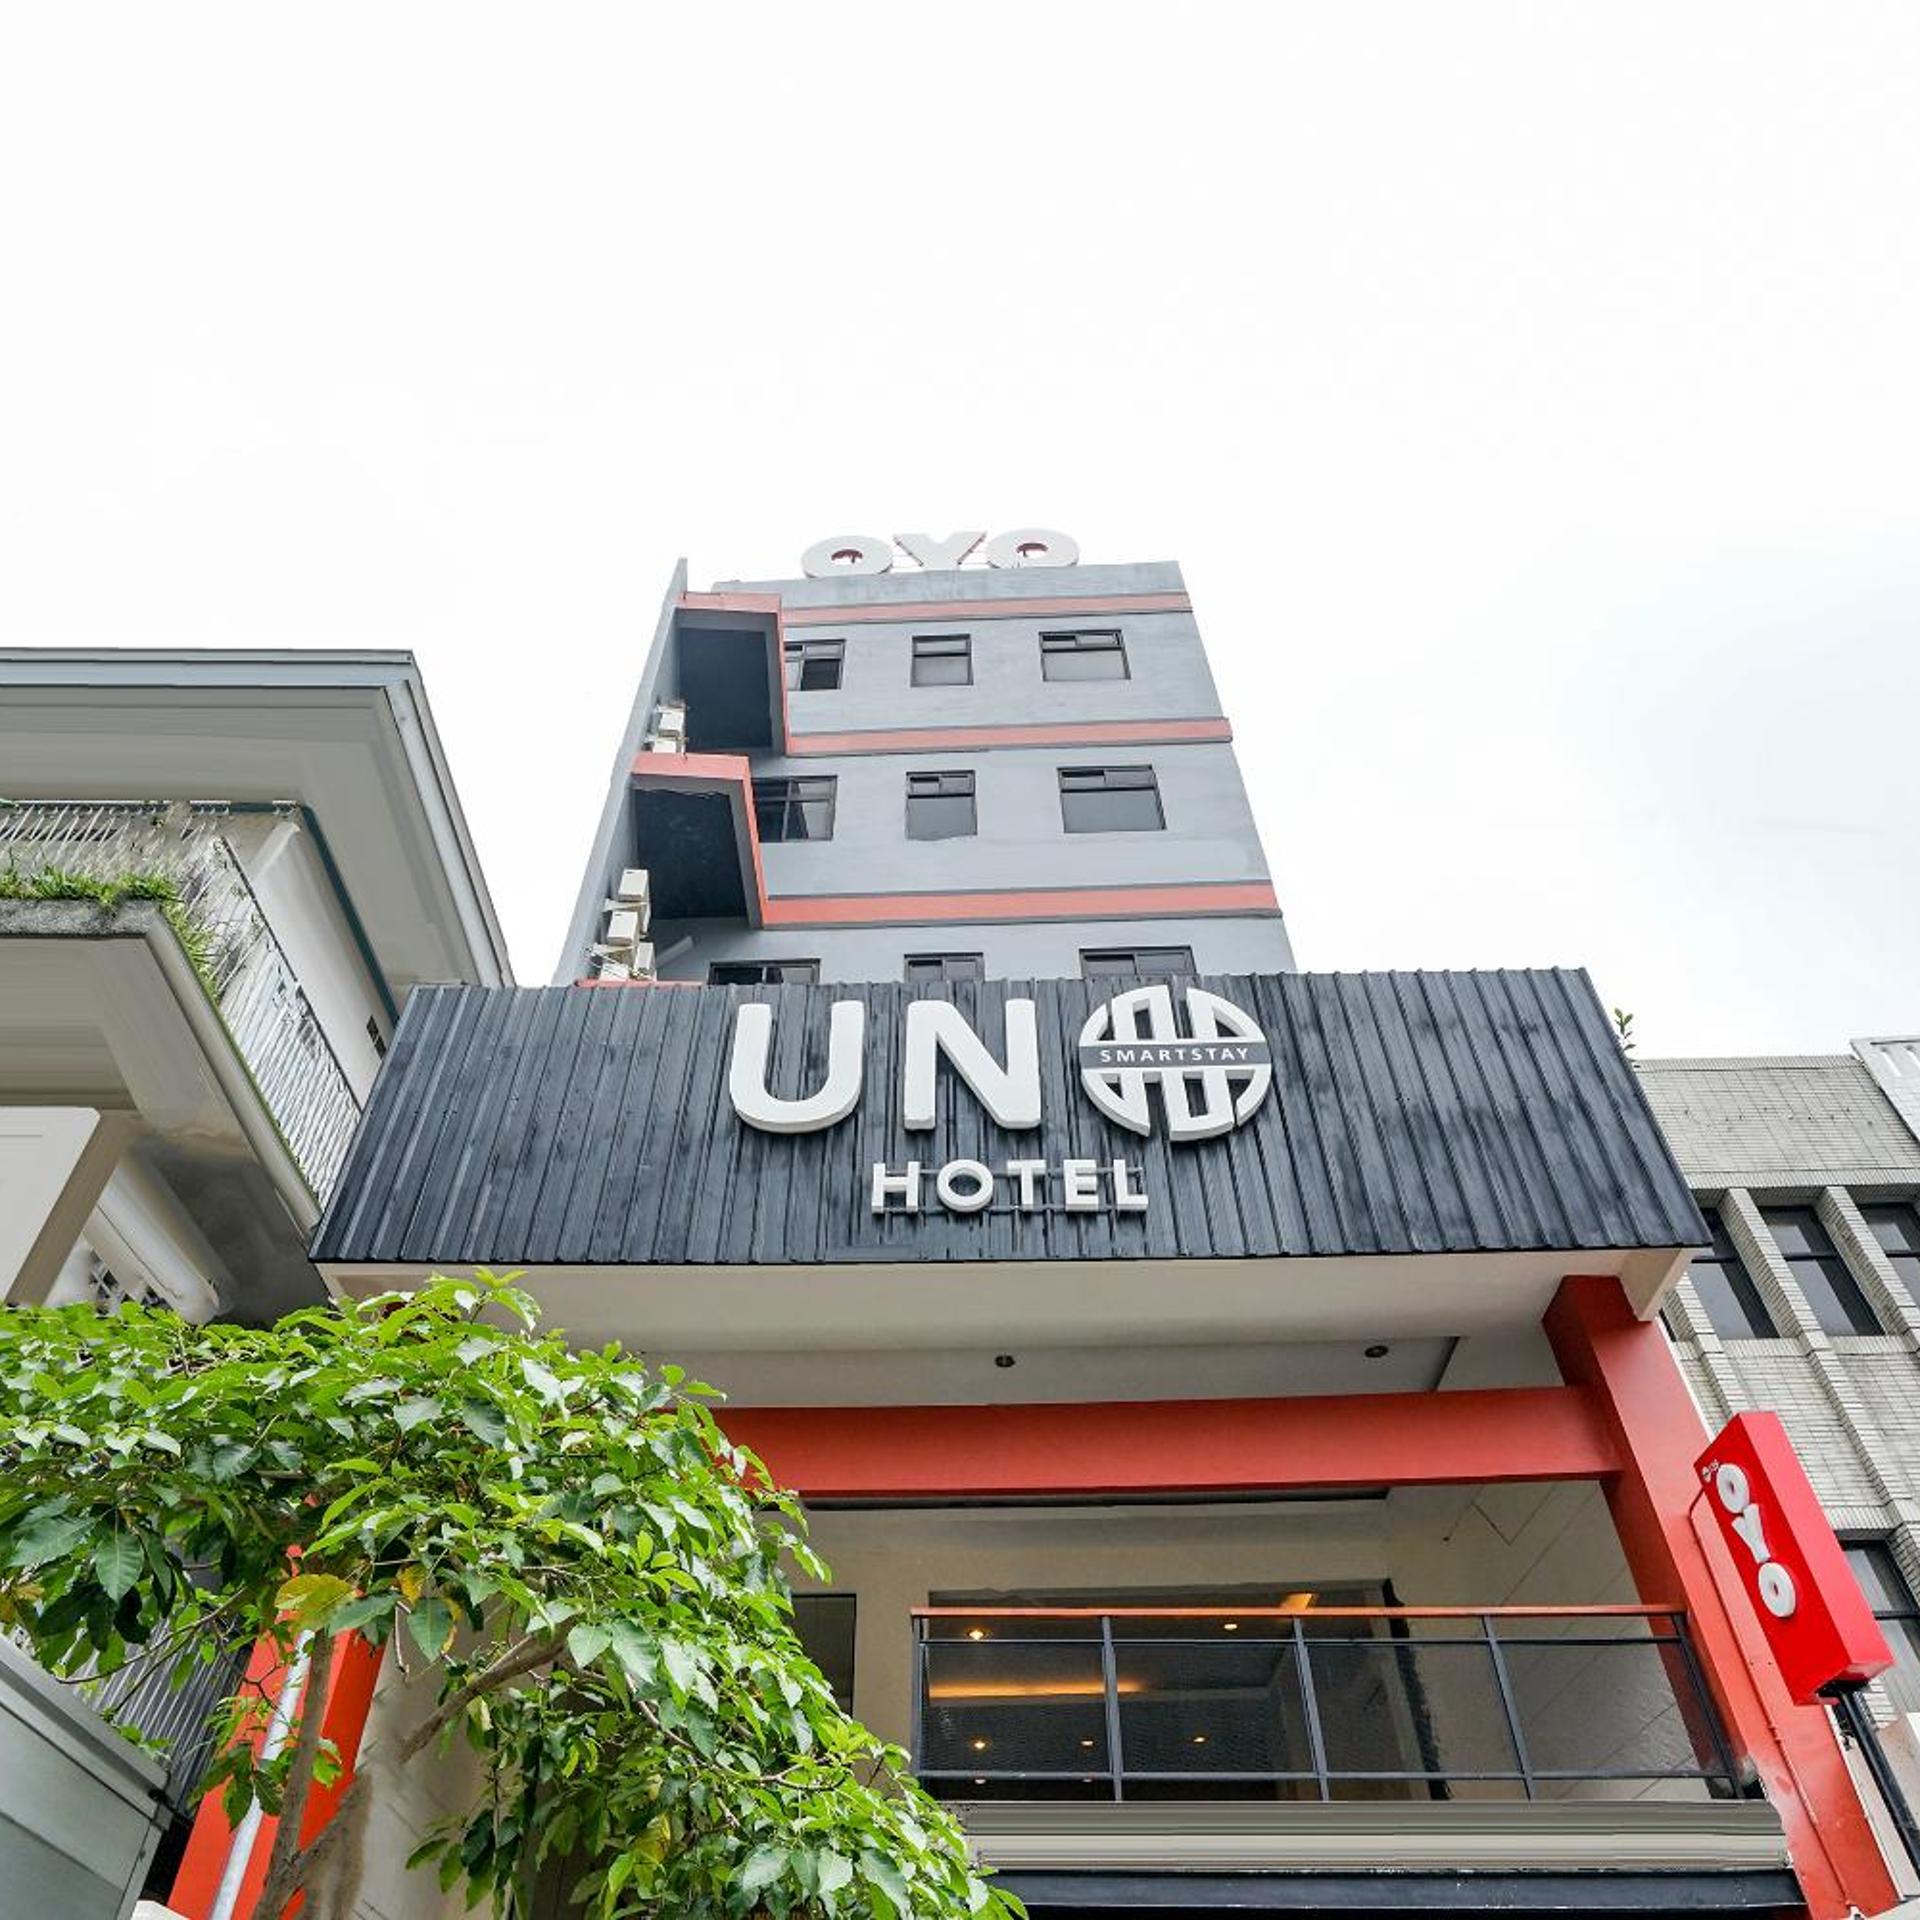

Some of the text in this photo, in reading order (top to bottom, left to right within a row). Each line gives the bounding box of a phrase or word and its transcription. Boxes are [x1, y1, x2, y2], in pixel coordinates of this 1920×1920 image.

[801, 528, 1080, 578] OYO
[1100, 1047, 1248, 1063] SMARTSTAY
[871, 1158, 1149, 1213] HOTEL
[1716, 1463, 1797, 1619] OYO
